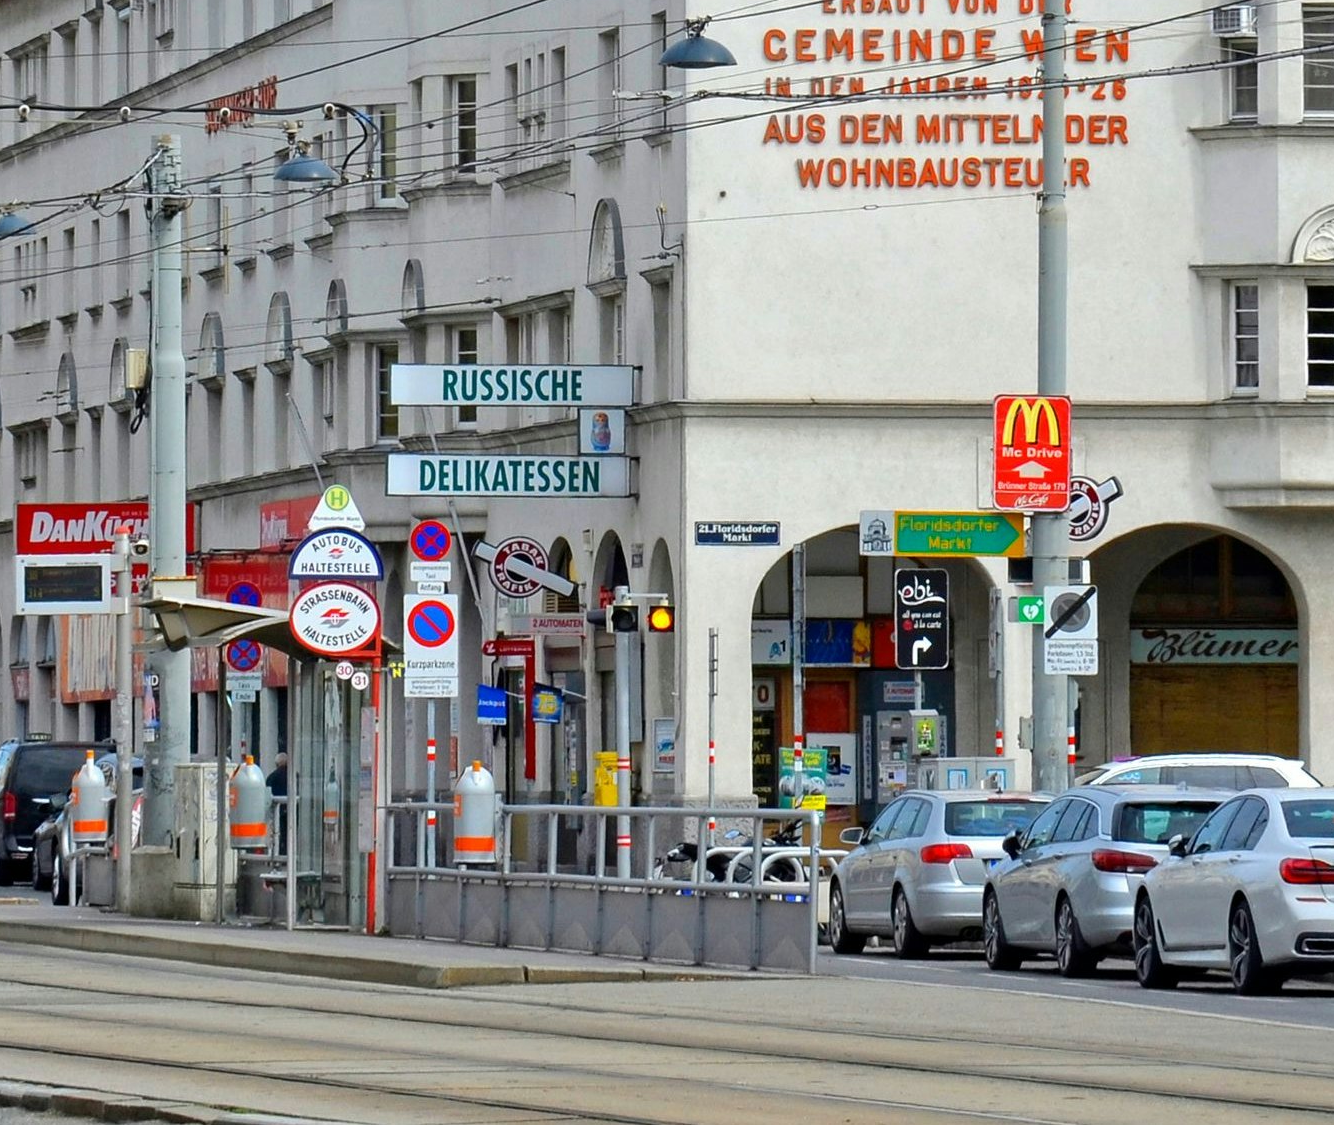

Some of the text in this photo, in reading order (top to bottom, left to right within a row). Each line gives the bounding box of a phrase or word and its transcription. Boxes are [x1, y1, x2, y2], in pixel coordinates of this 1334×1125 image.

[763, 28, 1130, 62] GEMEINDE WEN
[763, 115, 826, 145] AUS
[839, 115, 903, 145] DEN
[1065, 115, 1129, 145] DER
[797, 157, 1091, 189] WOHNBAUSTEUR
[442, 369, 583, 401] RUSSISCHE
[1002, 447, 1063, 458] Mc Drive
[419, 459, 600, 492] DELIKATESSEN
[900, 516, 999, 532] Floridsdorfer
[312, 535, 362, 554] AUTOBUS
[722, 533, 752, 542] Markt
[928, 535, 972, 550] Markt
[502, 542, 545, 566] TABAK
[301, 562, 371, 574] HALTESTELLE
[495, 563, 533, 593] TRAFIK
[419, 583, 442, 593] Anfang
[300, 589, 371, 615] STRASSENBAHN
[538, 618, 585, 628] AUTOMATEN
[302, 624, 368, 646] HALTESTELLE
[337, 665, 353, 675] 30
[407, 659, 455, 671] Kurzparkzone
[354, 676, 367, 686] 31
[235, 692, 252, 701] Ende
[478, 699, 506, 707] Jackpot
